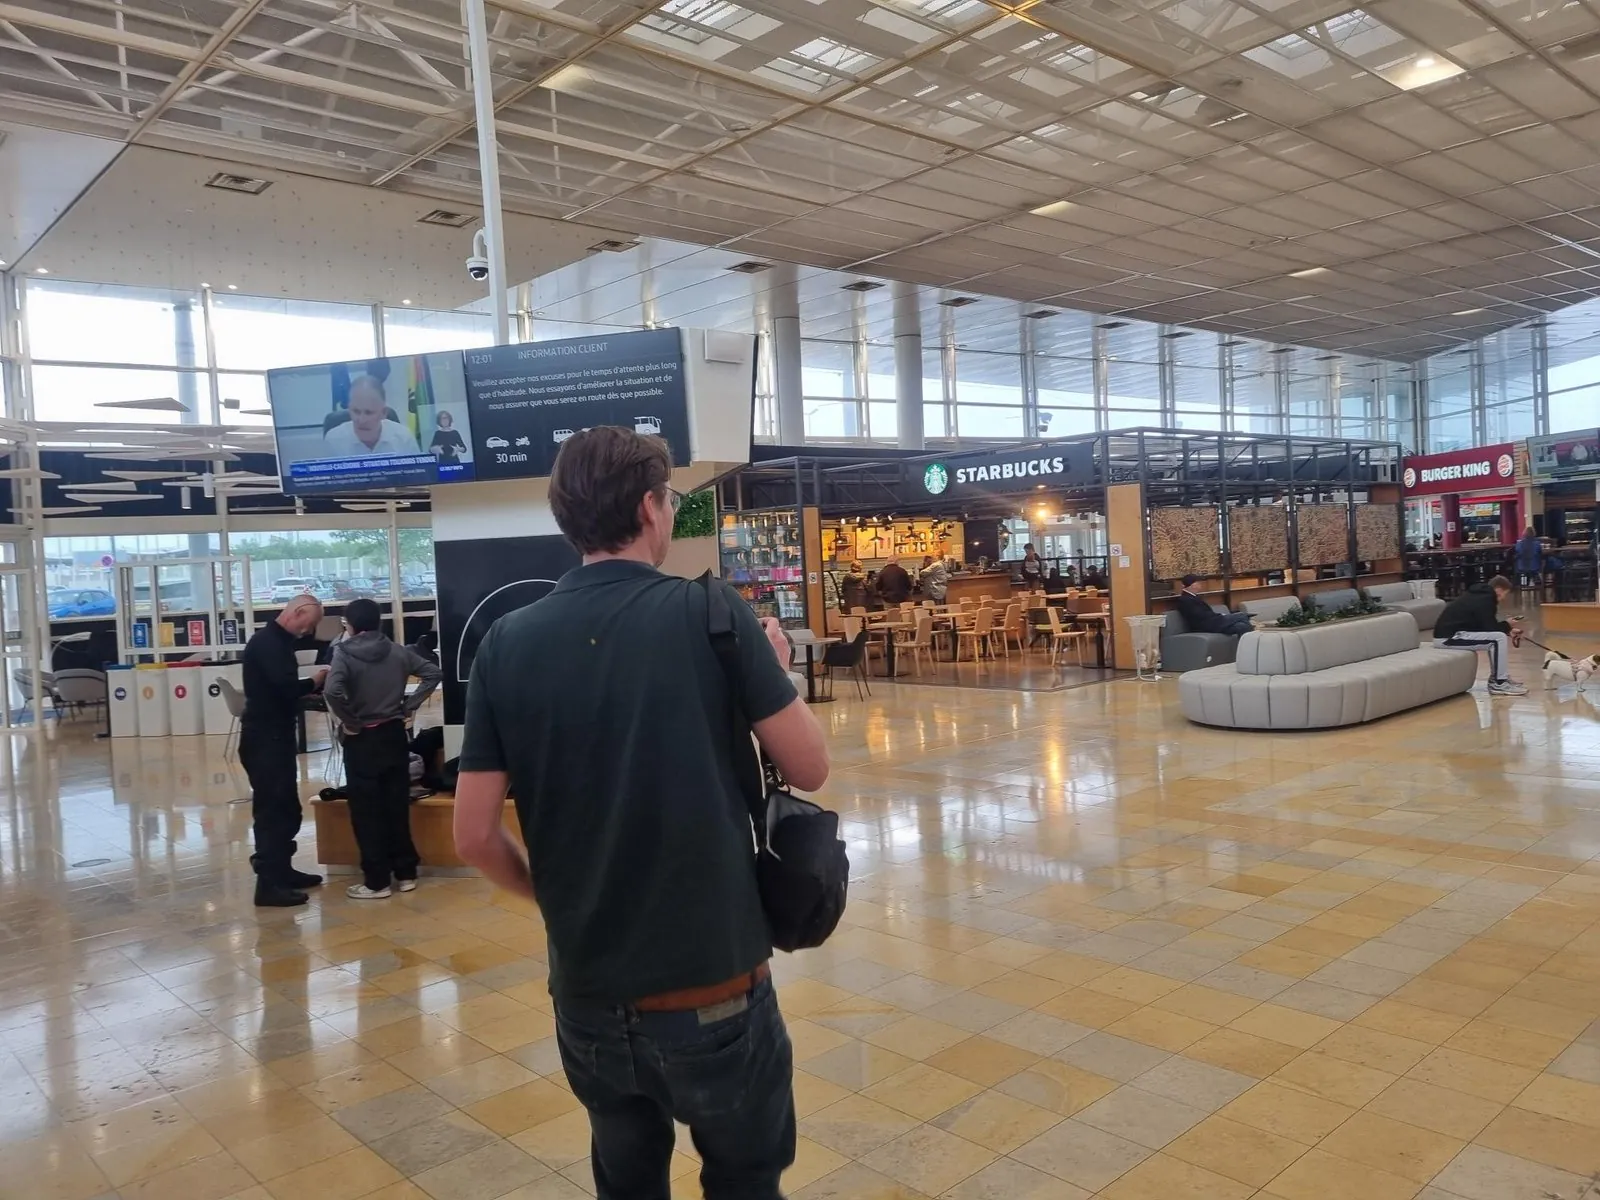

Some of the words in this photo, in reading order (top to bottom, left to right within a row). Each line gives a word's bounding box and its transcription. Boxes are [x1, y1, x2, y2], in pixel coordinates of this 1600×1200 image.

[471, 354, 492, 365] 12:01
[518, 345, 577, 360] INFORMATION
[578, 342, 608, 354] CLIENT
[472, 379, 498, 387] Veuillez
[498, 376, 527, 386] accepter
[540, 373, 566, 381] excuses
[566, 371, 582, 380] pour
[583, 369, 591, 377] le
[591, 368, 613, 377] temps
[613, 365, 645, 374] d'attente
[645, 363, 659, 372] plus
[660, 362, 677, 370] long
[478, 392, 491, 400] que
[492, 389, 528, 398] d'habitude.
[528, 387, 546, 395] Nous
[546, 384, 577, 394] essayons
[577, 380, 615, 391] d'améliorer
[615, 379, 623, 387] la
[624, 376, 654, 386] situation
[655, 375, 663, 383] et
[663, 374, 673, 382] de
[505, 400, 530, 409] assurer
[530, 400, 543, 408] que
[560, 396, 577, 404] serez
[588, 393, 606, 401] route
[607, 391, 619, 399] dès
[620, 391, 633, 399] que
[634, 387, 664, 398] possible.
[495, 453, 508, 463] 30
[509, 452, 527, 462] min
[956, 457, 1064, 484] STARBUCKS
[1421, 465, 1461, 482] BURGER
[1463, 461, 1490, 477] KING
